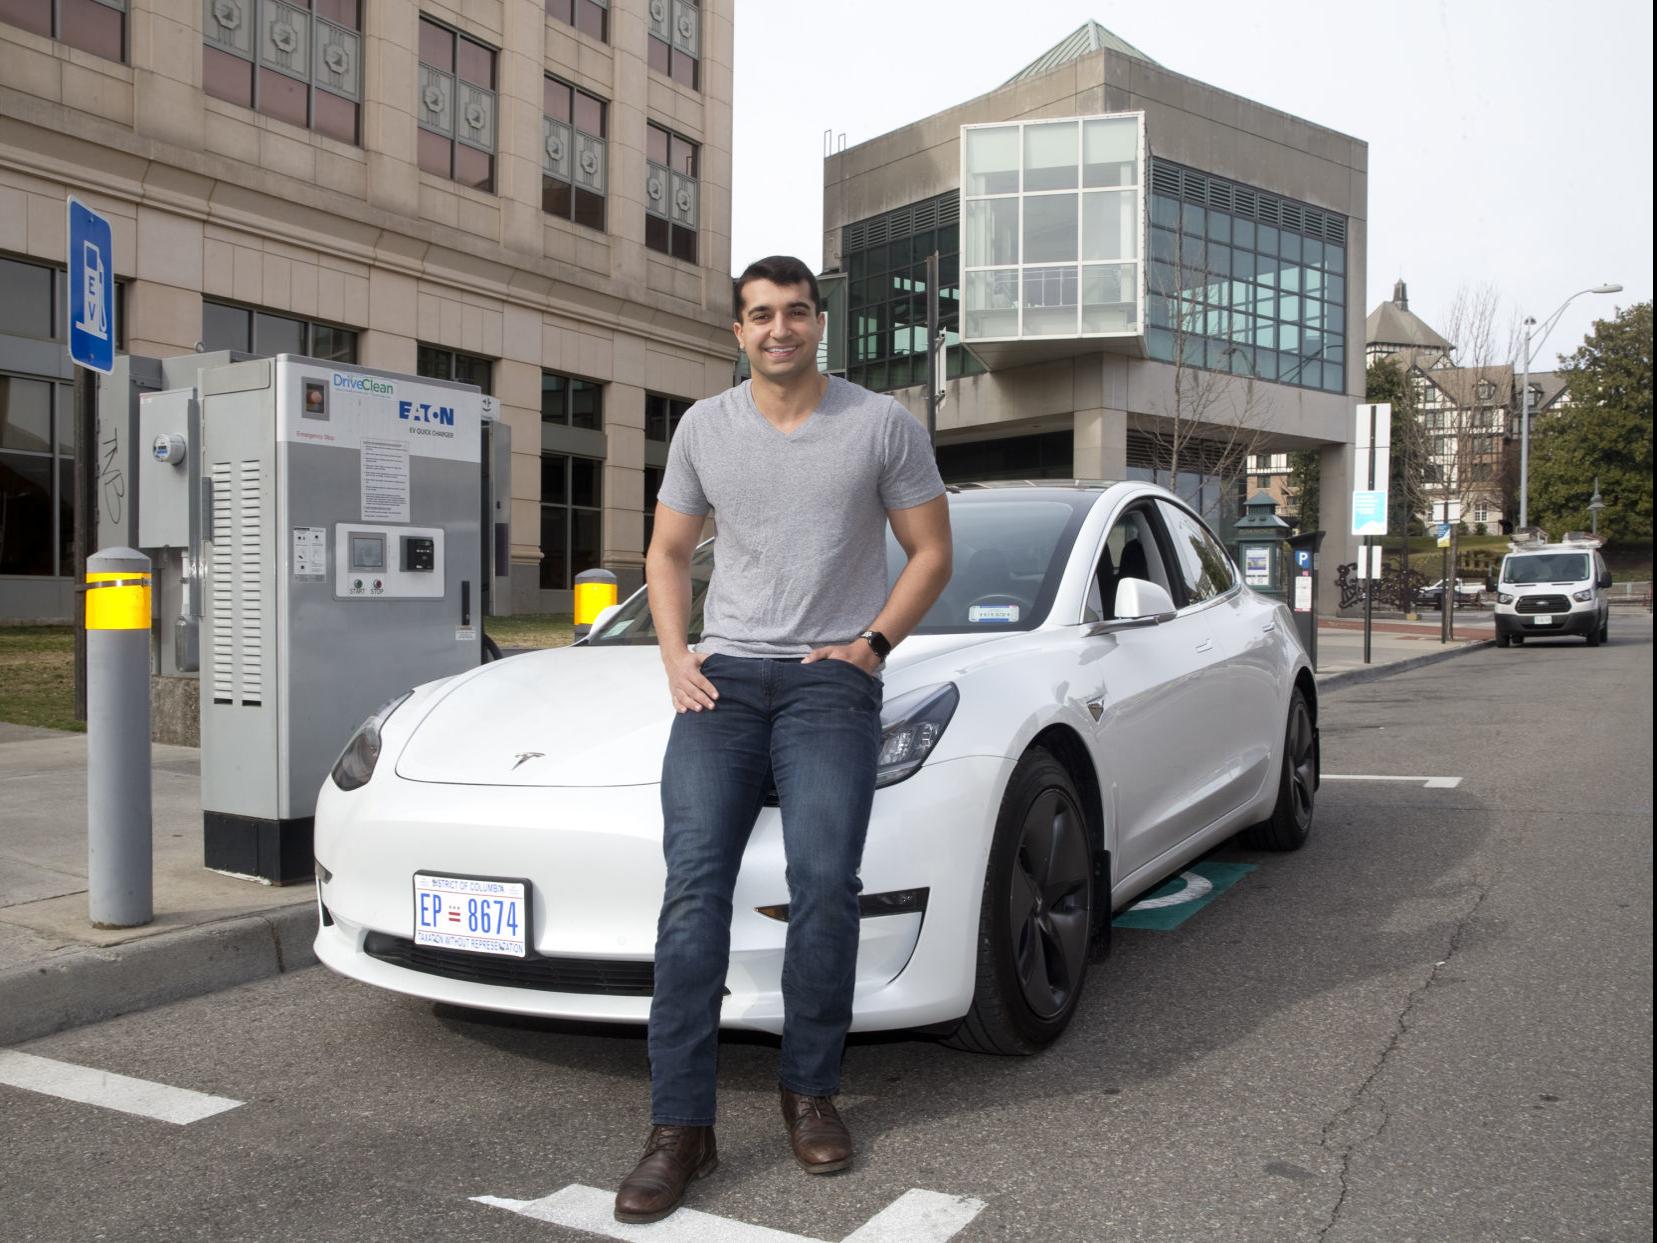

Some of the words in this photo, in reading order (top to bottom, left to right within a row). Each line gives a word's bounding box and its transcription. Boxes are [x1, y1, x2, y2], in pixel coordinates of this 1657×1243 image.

[333, 373, 394, 394] DriveClean
[399, 400, 454, 426] EATON
[1299, 551, 1310, 566] P
[420, 892, 442, 928] EP
[467, 898, 519, 937] 8674
